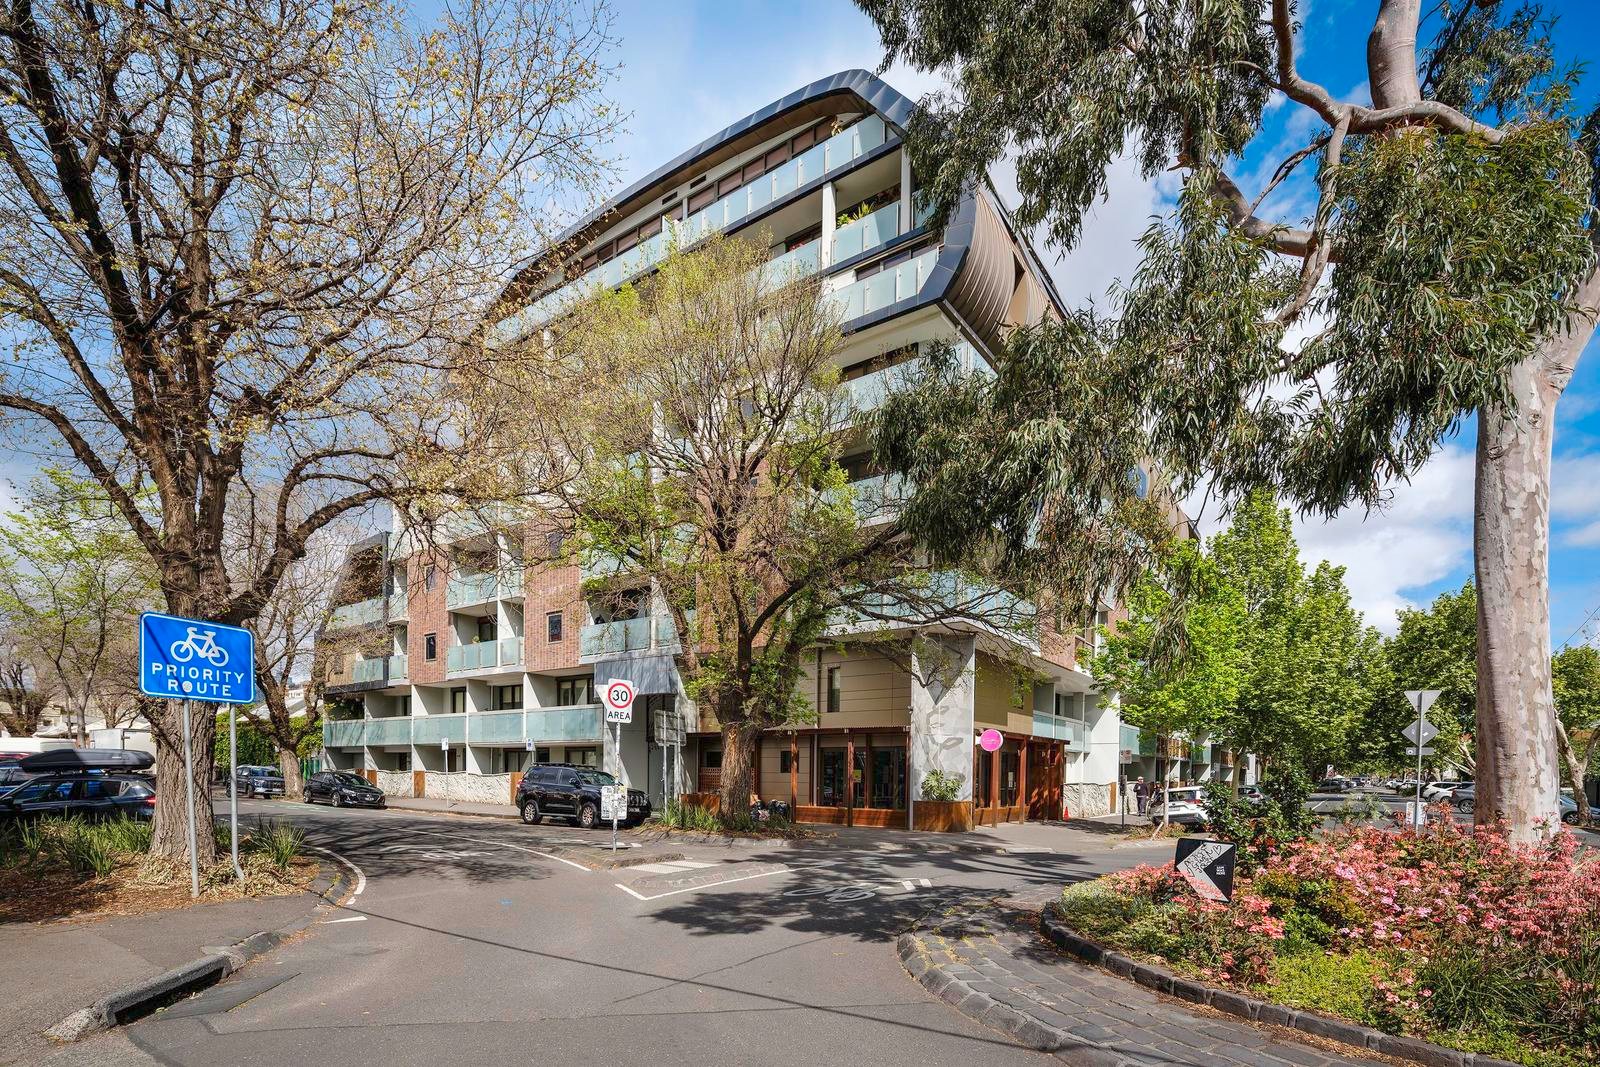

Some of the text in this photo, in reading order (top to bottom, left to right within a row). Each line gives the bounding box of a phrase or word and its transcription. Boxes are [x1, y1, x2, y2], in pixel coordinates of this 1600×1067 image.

[151, 662, 245, 684] PRIORITY
[168, 679, 232, 697] ROUTE
[612, 689, 628, 702] 30
[607, 710, 631, 720] AREA
